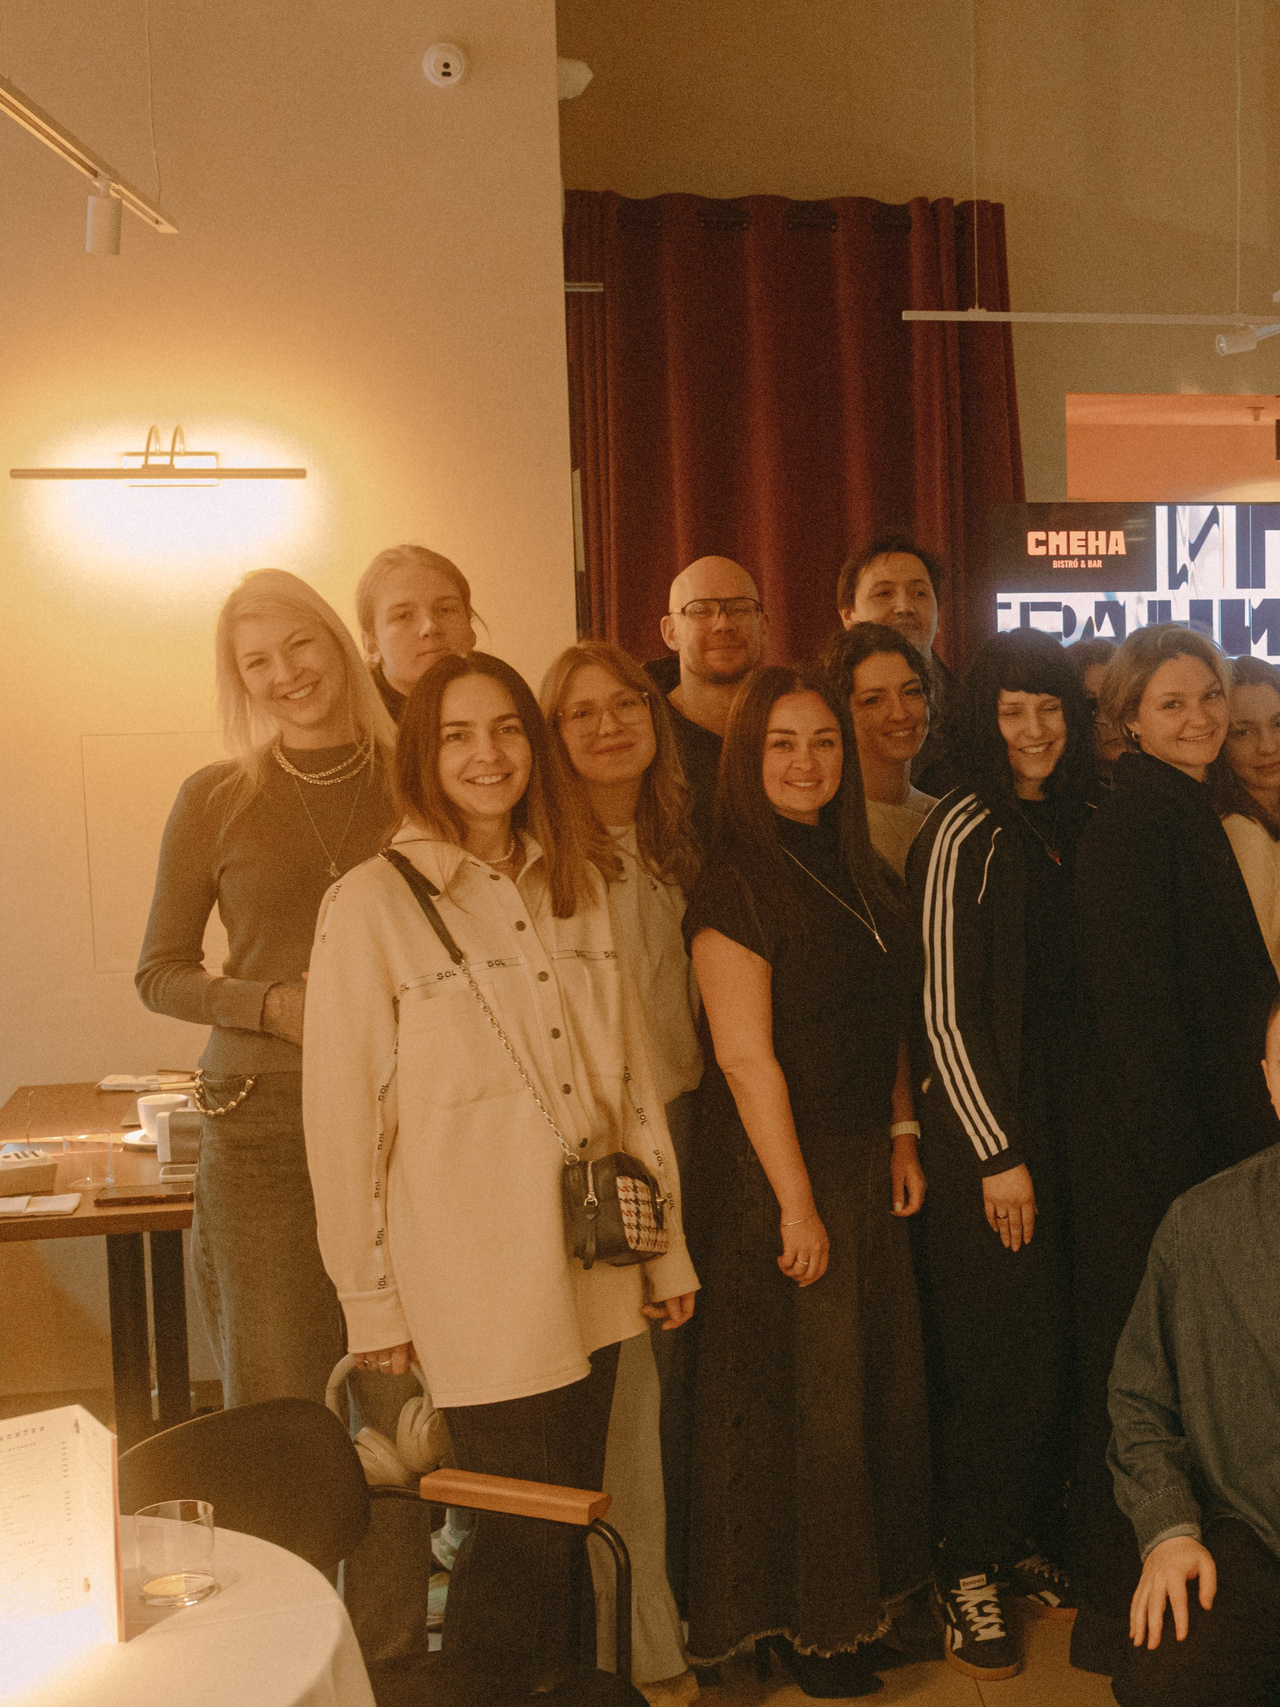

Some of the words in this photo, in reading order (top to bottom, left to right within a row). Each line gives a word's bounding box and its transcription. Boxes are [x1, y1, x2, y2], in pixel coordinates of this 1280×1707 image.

[1027, 530, 1127, 555] СМЕНА
[1052, 558, 1079, 568] BISTRÓ
[1080, 560, 1086, 568] &
[1087, 560, 1102, 568] BAR
[436, 969, 458, 981] SOL
[486, 959, 506, 968] SOL
